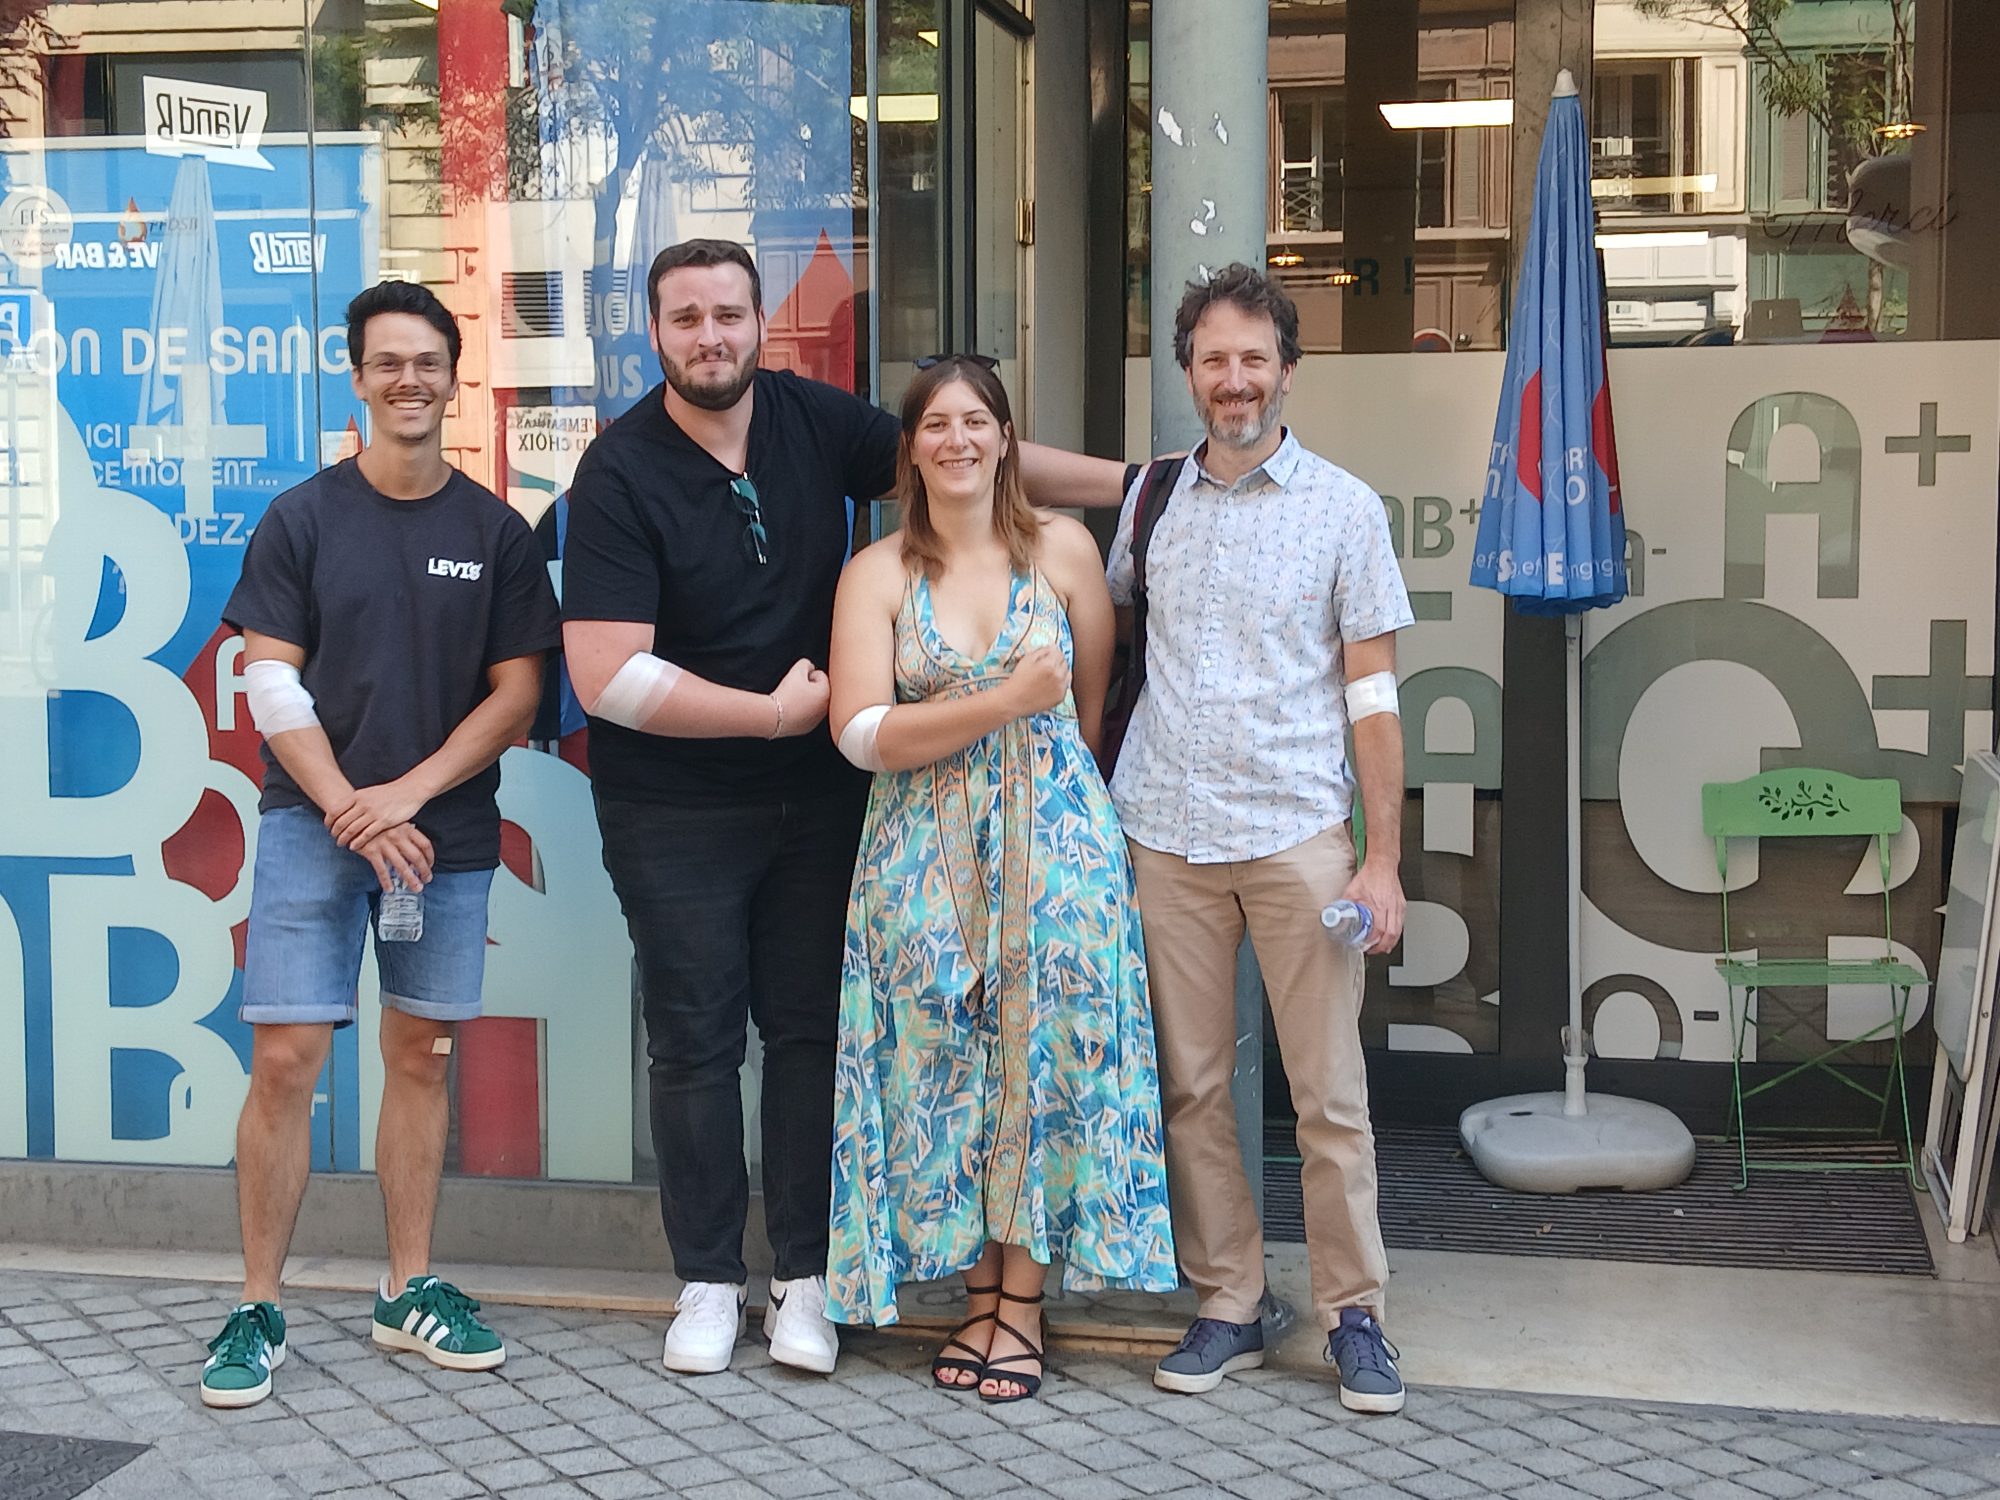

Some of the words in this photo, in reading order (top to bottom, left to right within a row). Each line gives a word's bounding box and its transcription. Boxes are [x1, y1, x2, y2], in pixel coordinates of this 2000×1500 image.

[122, 327, 189, 376] DE
[209, 327, 350, 376] SANG
[86, 423, 122, 448] ICI
[131, 460, 278, 486] MOENT...
